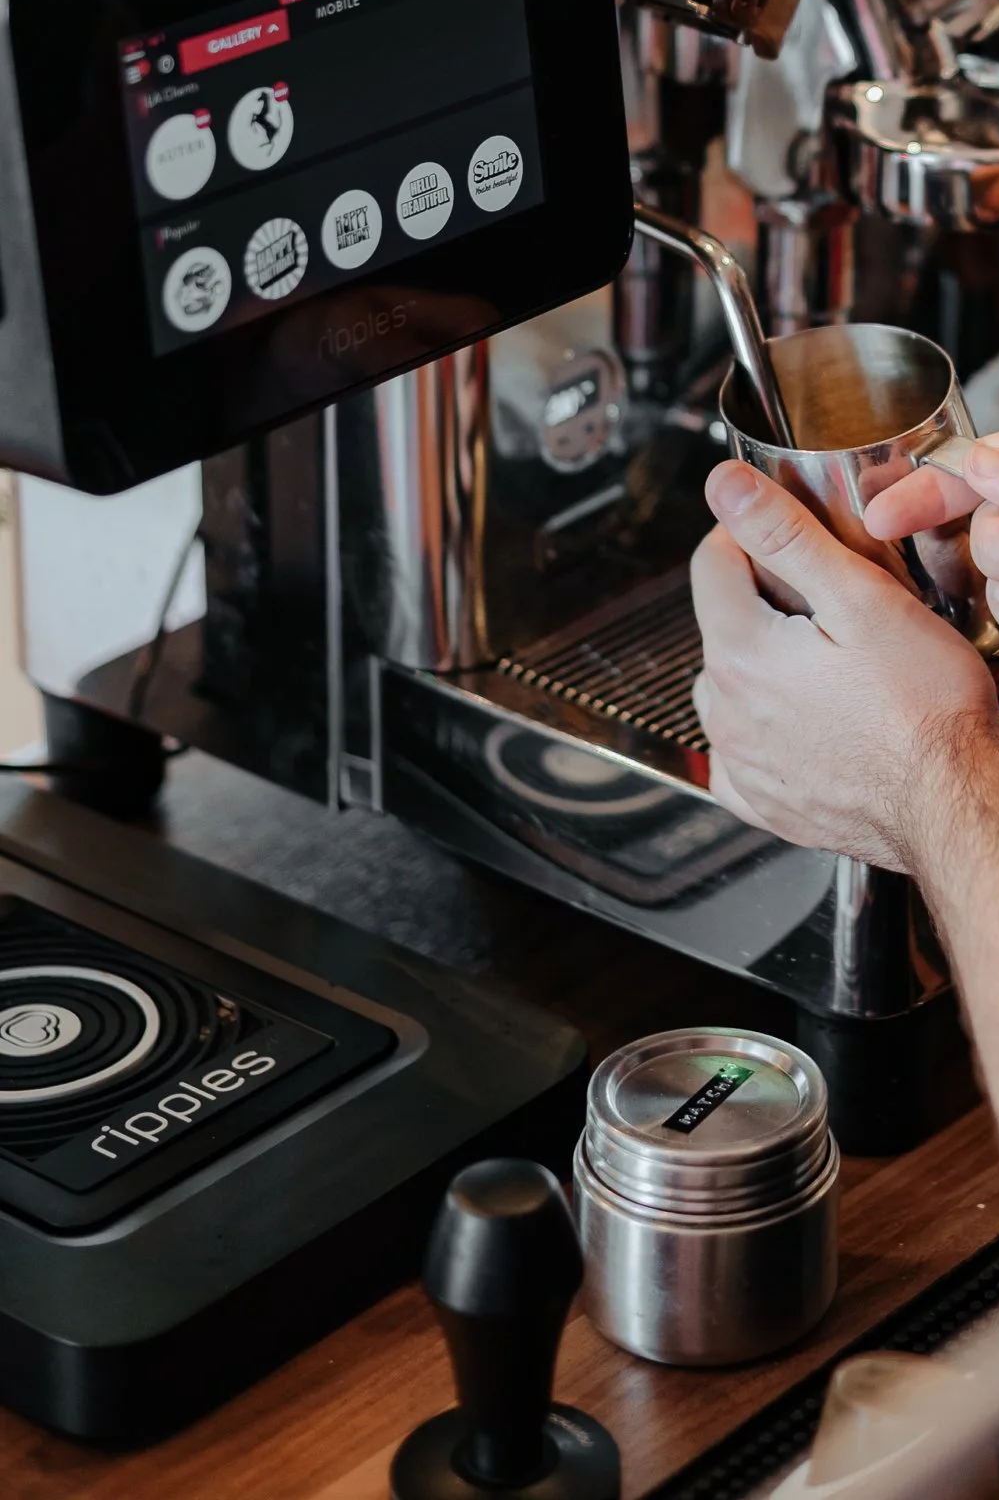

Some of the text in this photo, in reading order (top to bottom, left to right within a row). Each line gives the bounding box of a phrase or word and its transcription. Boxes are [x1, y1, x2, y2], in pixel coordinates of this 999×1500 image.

[207, 25, 262, 53] GALLERY
[473, 151, 519, 183] Smile
[409, 173, 438, 198] HELLO
[401, 187, 450, 219] BEAUTIFUL
[335, 205, 368, 237] HAPPY
[91, 1050, 276, 1159] ripples
